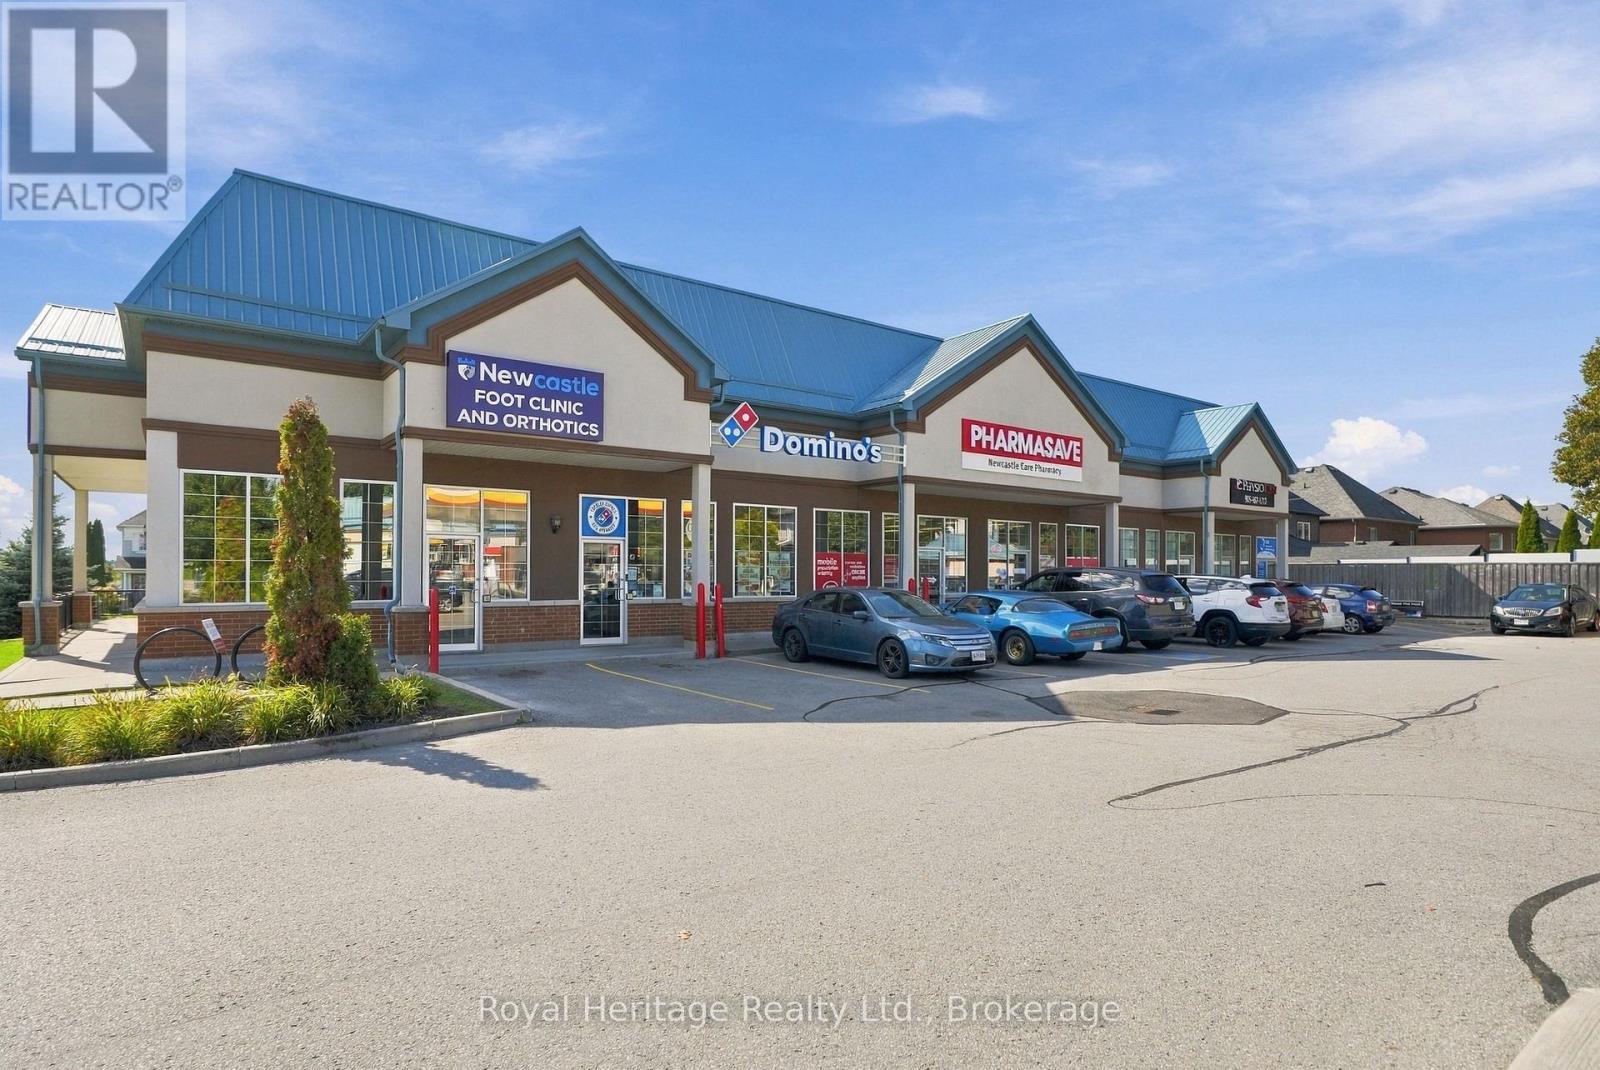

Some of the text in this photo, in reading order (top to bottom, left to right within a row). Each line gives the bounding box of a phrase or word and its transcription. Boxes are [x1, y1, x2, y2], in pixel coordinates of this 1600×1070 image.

[479, 361, 599, 396] Newcastle
[474, 389, 584, 416] FOOT CLINIC
[456, 408, 599, 437] AND ORTHOTICS
[760, 425, 882, 464] Domino's
[970, 423, 1081, 463] PHARMASAVE
[988, 458, 1062, 477] Newcastle Care Pharmacy
